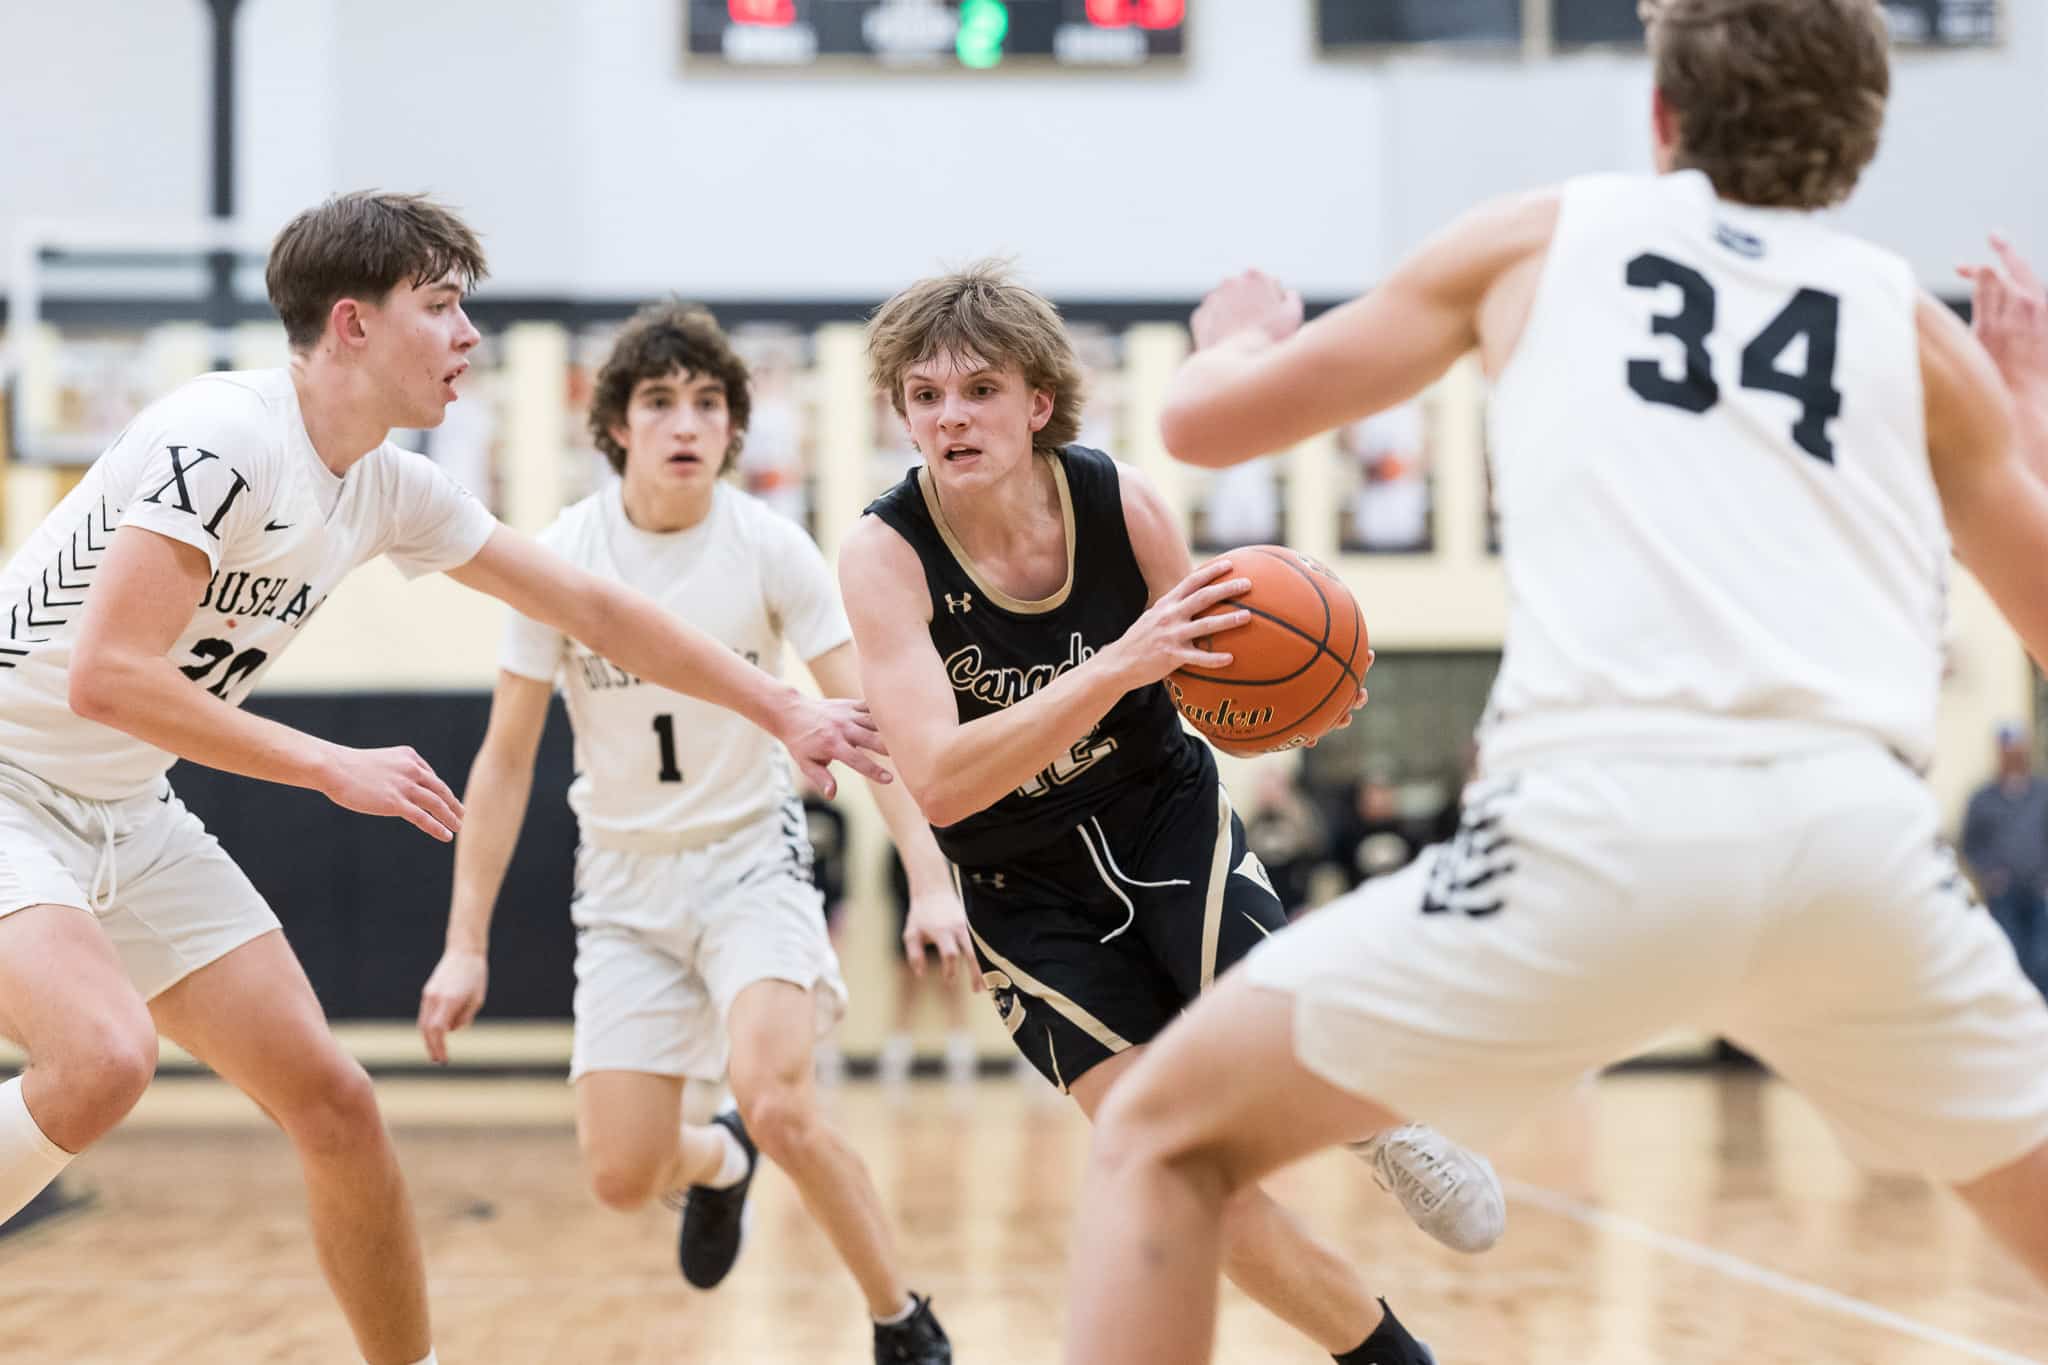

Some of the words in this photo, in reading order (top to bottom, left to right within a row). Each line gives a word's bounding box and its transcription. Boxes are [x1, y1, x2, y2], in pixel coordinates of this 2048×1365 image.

[1626, 253, 1841, 466] 34
[143, 445, 250, 540] XI
[653, 714, 683, 782] 1
